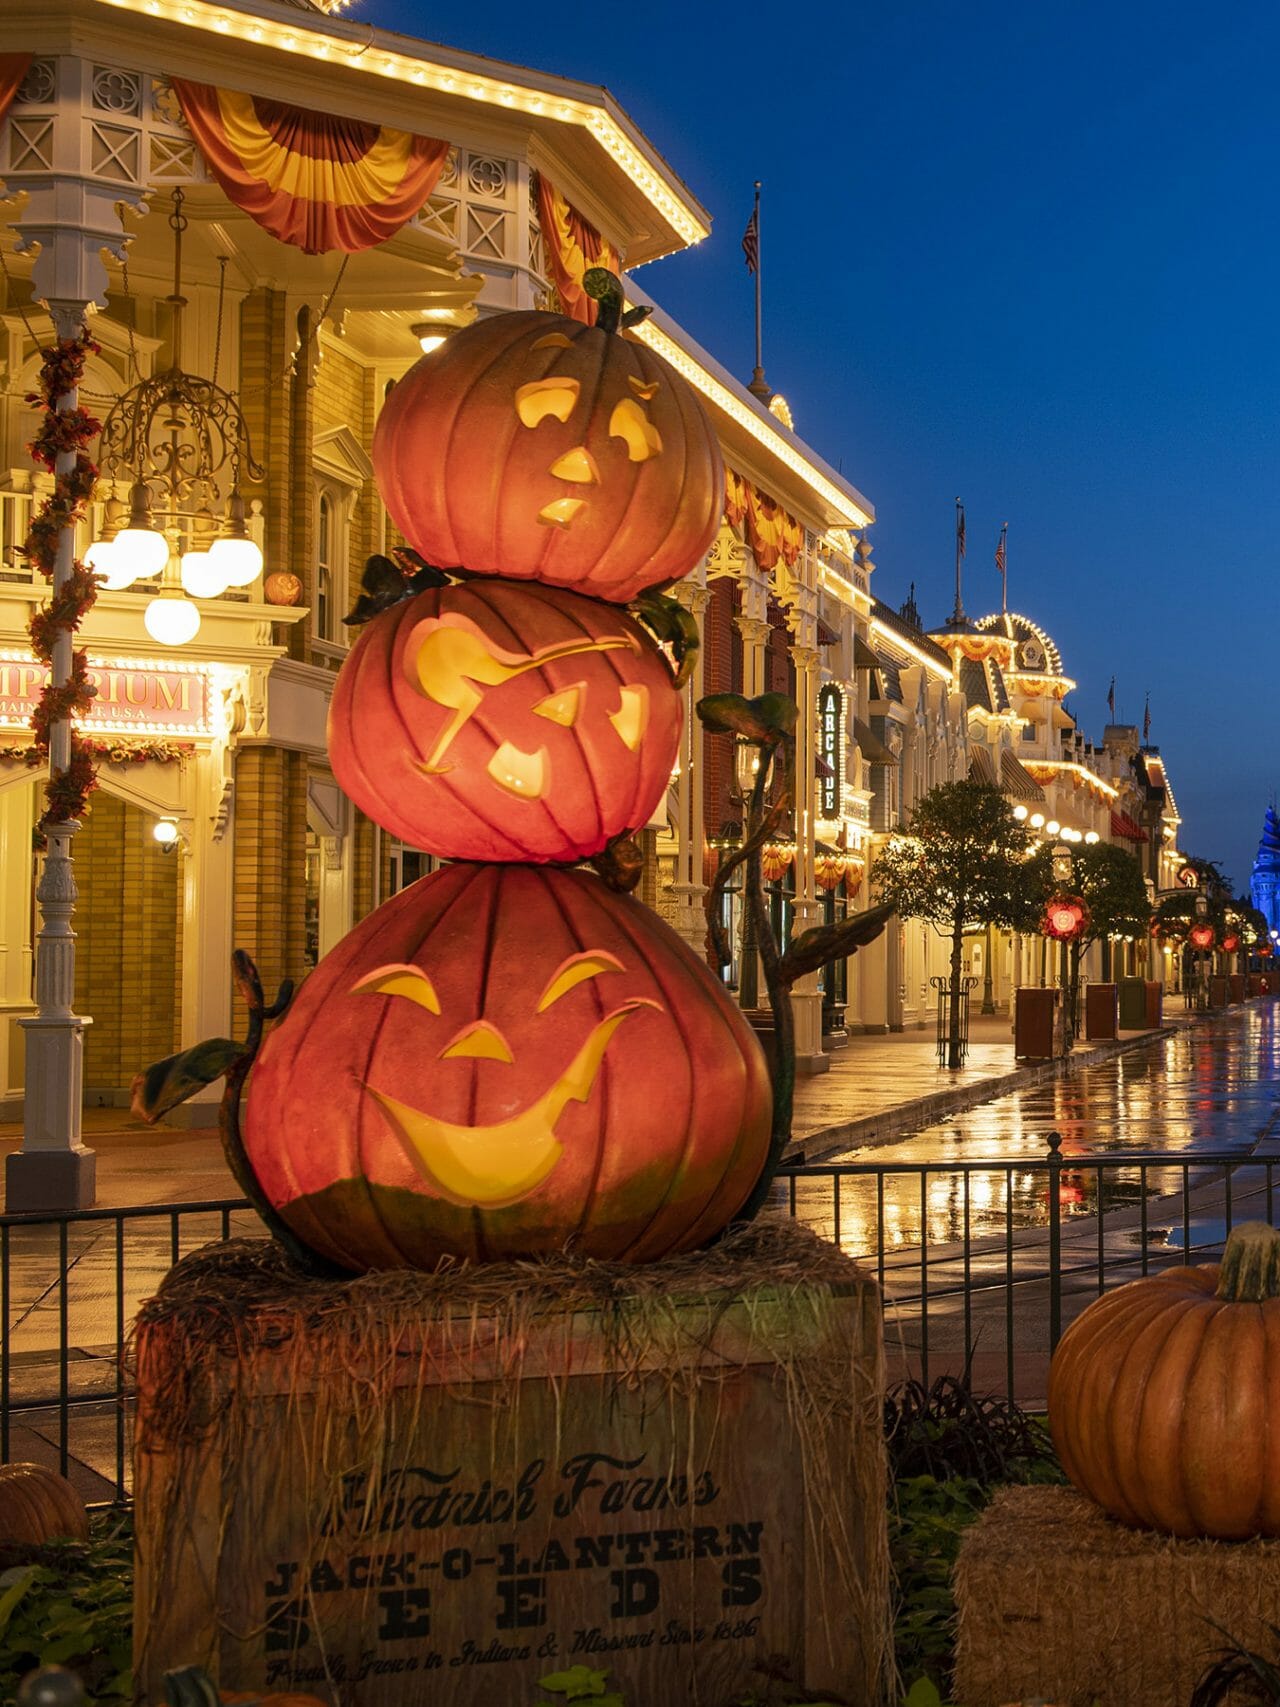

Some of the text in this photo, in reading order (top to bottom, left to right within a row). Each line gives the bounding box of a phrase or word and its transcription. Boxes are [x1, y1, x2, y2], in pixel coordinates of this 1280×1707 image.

[0, 666, 191, 712] PRIUM
[111, 706, 150, 719] U.S.A.
[825, 694, 835, 810] ARCADE
[553, 1452, 719, 1517] Farms
[266, 1522, 764, 1597] JACK-O-LANTERN
[265, 1557, 763, 1652] SEEDS
[423, 1650, 444, 1671] in
[449, 1638, 530, 1667] Indiana
[537, 1631, 559, 1659] &
[568, 1628, 655, 1655] Missouri
[659, 1618, 705, 1647] Since
[711, 1616, 761, 1641] 1886
